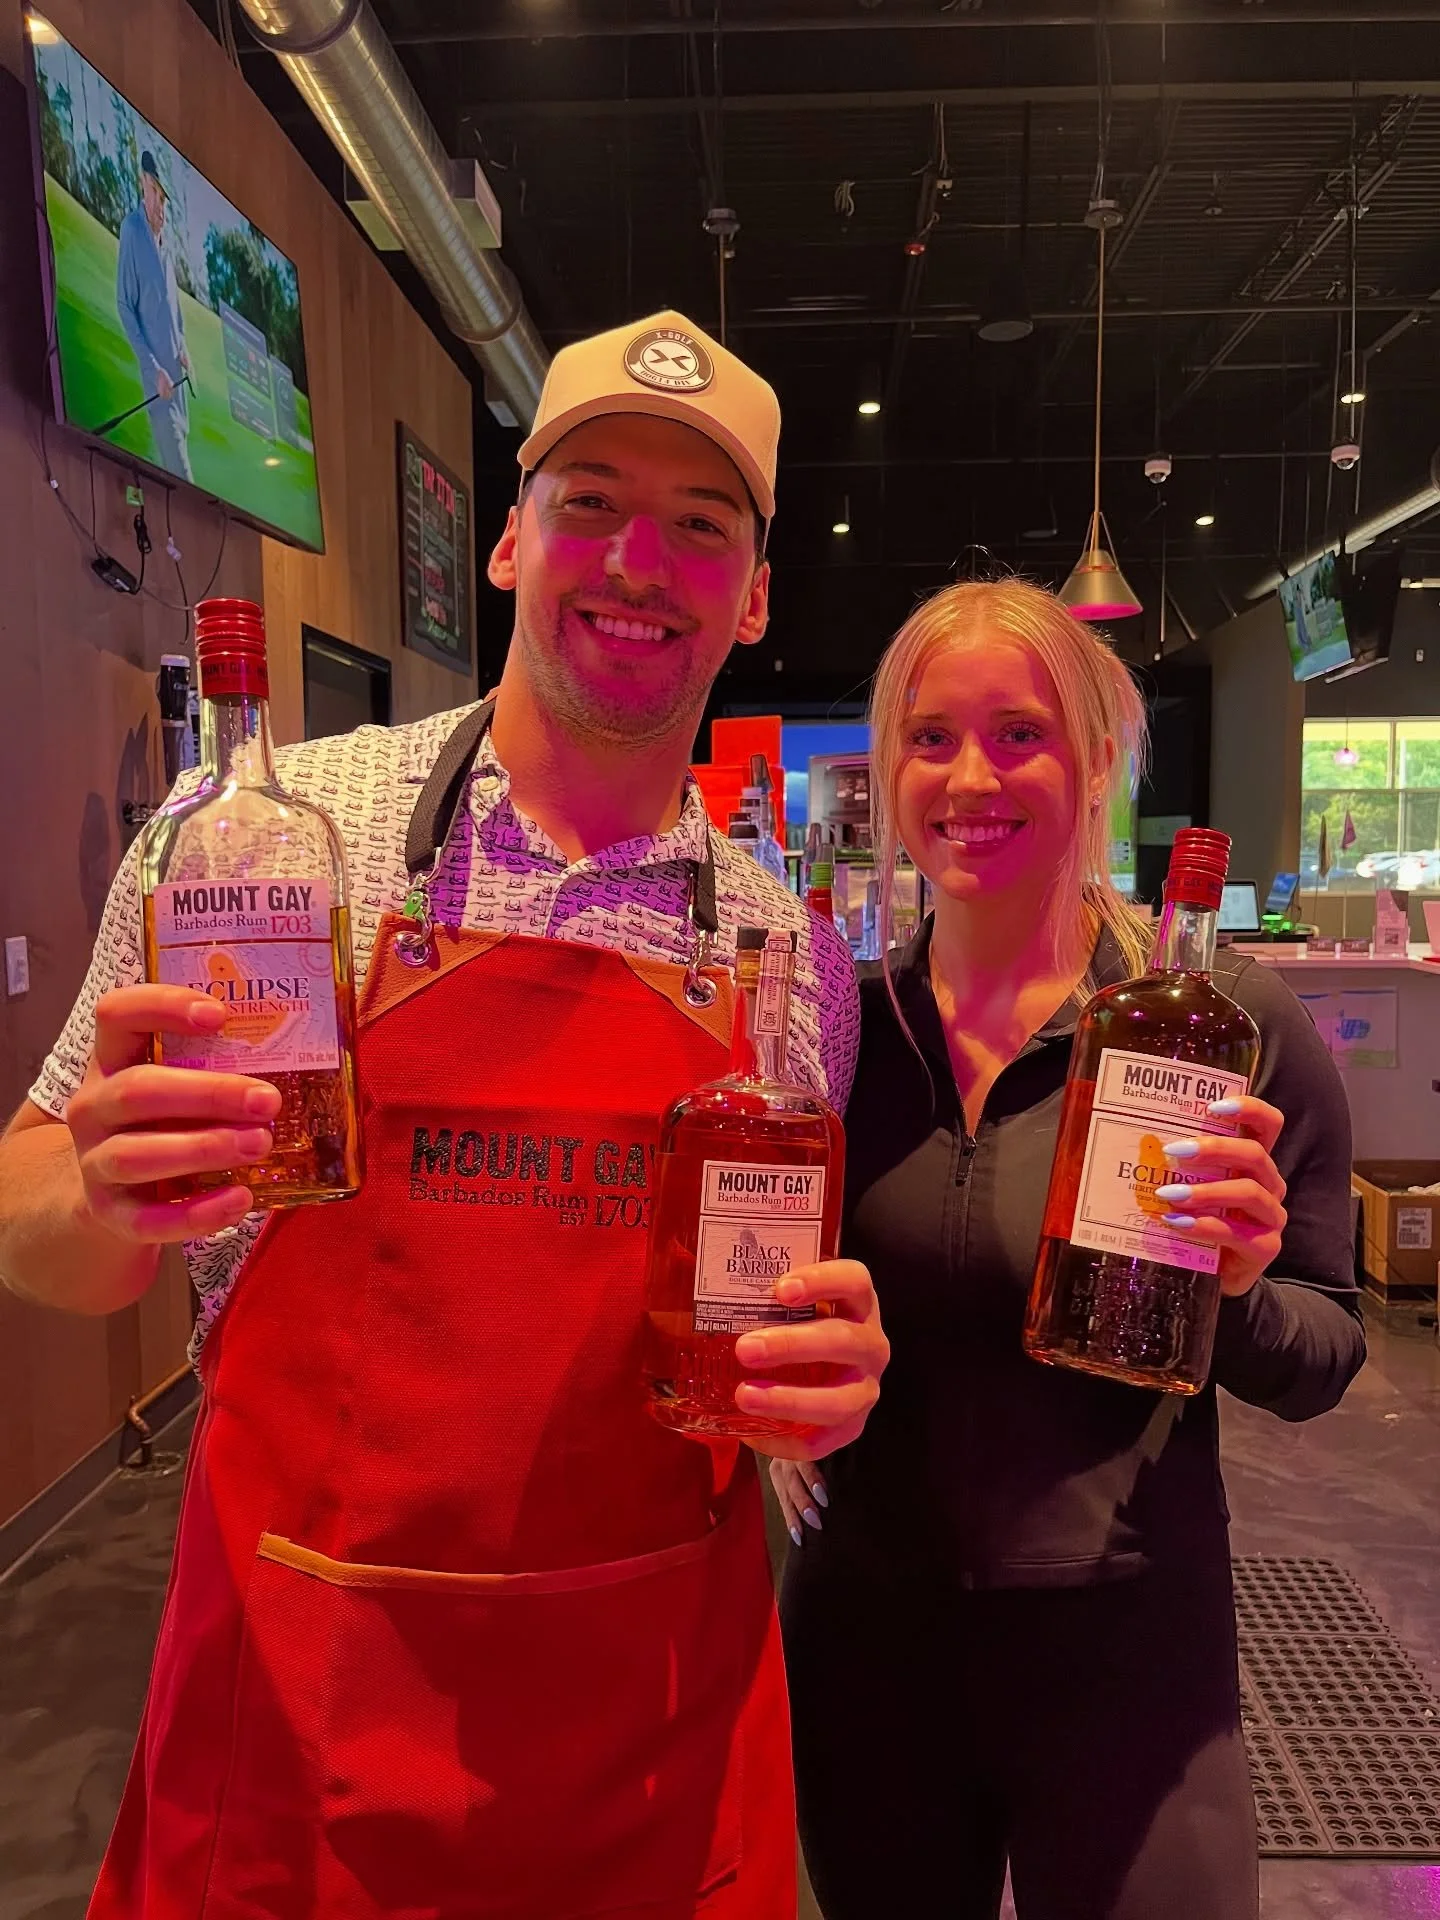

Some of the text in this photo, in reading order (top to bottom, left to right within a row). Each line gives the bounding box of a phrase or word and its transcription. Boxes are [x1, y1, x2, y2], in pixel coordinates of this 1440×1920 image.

[172, 885, 312, 916] MOUNT GAY
[174, 914, 311, 934] Barbados Rum 1703
[229, 1000, 310, 1014] STRENGTH
[1124, 1064, 1227, 1101] MOUNT GAY
[1122, 1085, 1168, 1102] Barbados
[1170, 1094, 1192, 1107] Rum
[411, 1127, 584, 1183] MOUNT
[408, 1178, 526, 1206] Barbados
[532, 1184, 589, 1210] Rum
[718, 1171, 812, 1195] MOUNT GAY
[718, 1192, 809, 1210] Barbados Rum 1703
[559, 1212, 585, 1225] EST
[733, 1244, 791, 1260] BLACK
